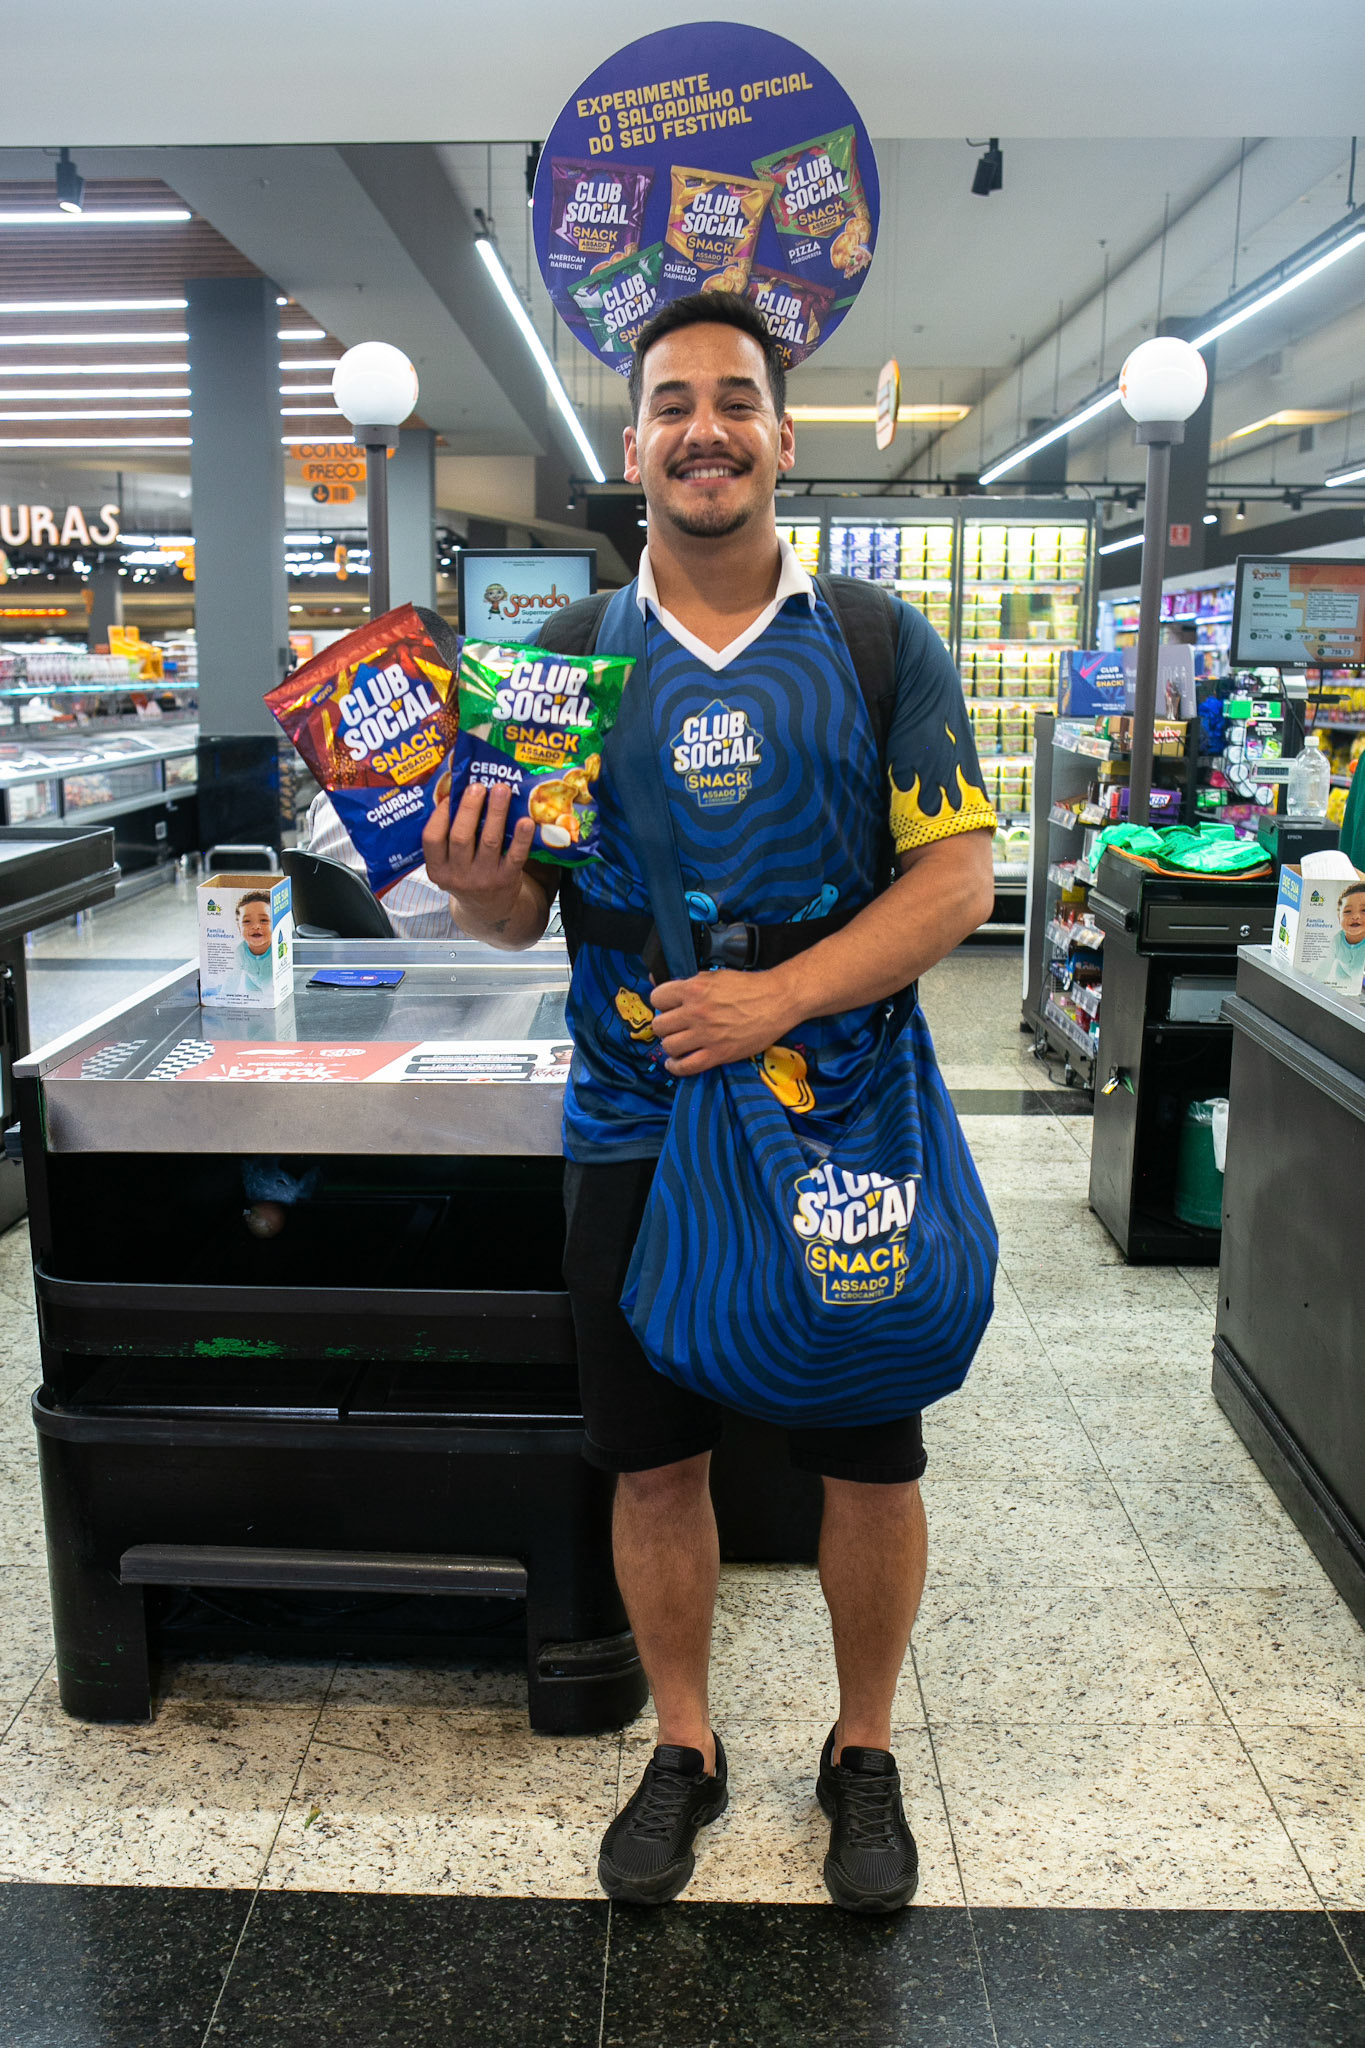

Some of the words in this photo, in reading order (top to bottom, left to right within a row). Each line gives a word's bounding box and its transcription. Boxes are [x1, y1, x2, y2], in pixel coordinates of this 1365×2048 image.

[576, 73, 710, 118] EXPERIMENTE
[598, 115, 611, 133] O
[617, 88, 734, 130] SALGADINHO
[740, 72, 813, 103] OFICIAL
[588, 134, 614, 155] DO
[620, 125, 656, 149] SEU
[662, 106, 752, 140] FESTIVAL
[786, 155, 832, 192] CLUB
[575, 181, 623, 203] CLUB
[692, 193, 742, 217] CLUB
[798, 200, 845, 226] SNACK
[573, 226, 619, 241] SNACK
[812, 217, 837, 230] ASSADO
[581, 240, 608, 249] ASSADO
[687, 238, 734, 256] SNACK
[788, 241, 821, 259] PIZZA
[549, 253, 586, 263] AMERICAN
[550, 261, 583, 271] BARBECUE
[695, 252, 722, 261] ASSADO
[663, 272, 696, 283] PARMESÃO
[664, 264, 697, 276] QUEIJO
[602, 273, 647, 312] CLUB
[755, 291, 802, 320] CLUB
[615, 360, 633, 372] CEBO
[0, 504, 120, 546] URAS
[510, 661, 588, 697] CLUB
[338, 663, 410, 727] CLUB
[505, 725, 579, 753] SNACK
[683, 711, 745, 744] CLUB
[371, 724, 442, 774] SNACK
[520, 745, 560, 761] ASSADO
[397, 750, 433, 777] ASSADO
[470, 761, 523, 782] CEBOLA
[688, 771, 748, 789] SNACK
[366, 785, 424, 824] CHURRAS
[703, 789, 736, 799] ASSADO
[378, 815, 393, 829] NA
[392, 799, 425, 824] BRASA
[229, 1065, 333, 1078] break
[810, 1244, 906, 1273] SNACK
[831, 1276, 889, 1291] ASSADO
